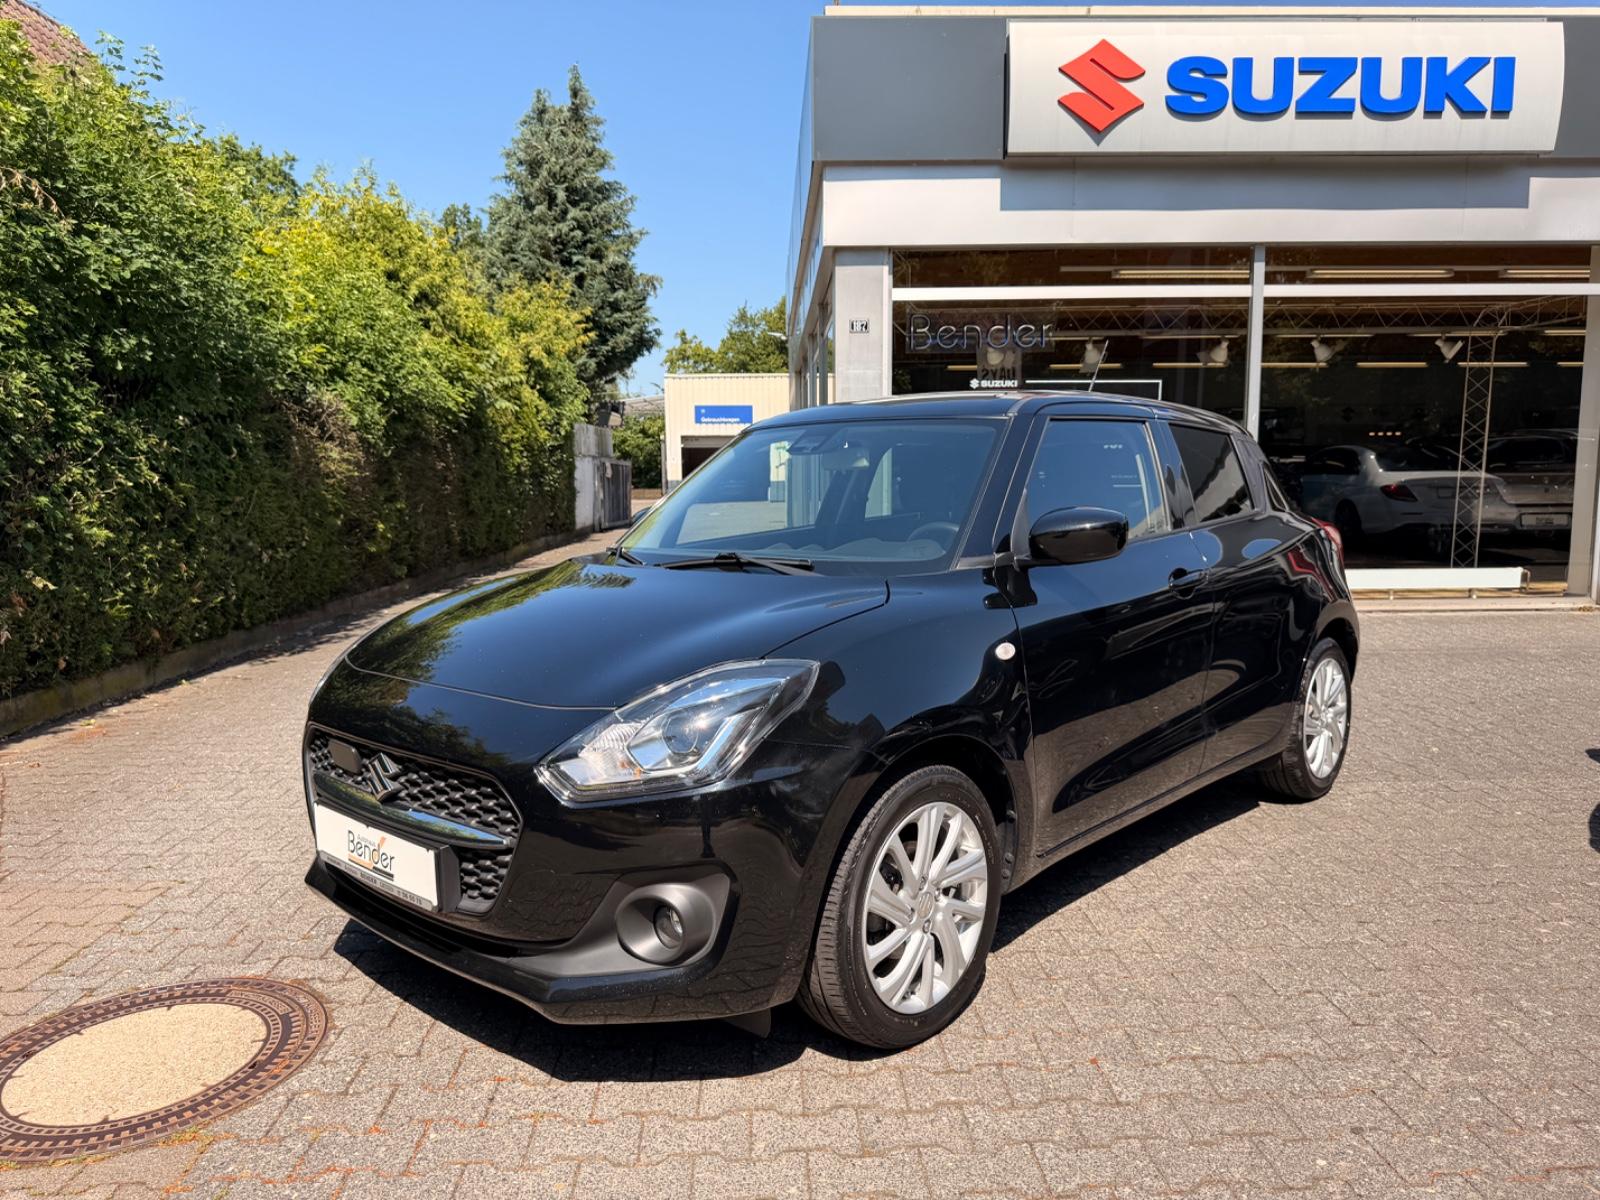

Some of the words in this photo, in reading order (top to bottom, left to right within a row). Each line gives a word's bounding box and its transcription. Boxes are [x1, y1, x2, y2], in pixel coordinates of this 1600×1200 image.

[1165, 56, 1516, 115] SUZUKI
[911, 314, 1052, 350] Bender
[980, 380, 1018, 388] SUZUKI
[347, 830, 395, 871] Bender
